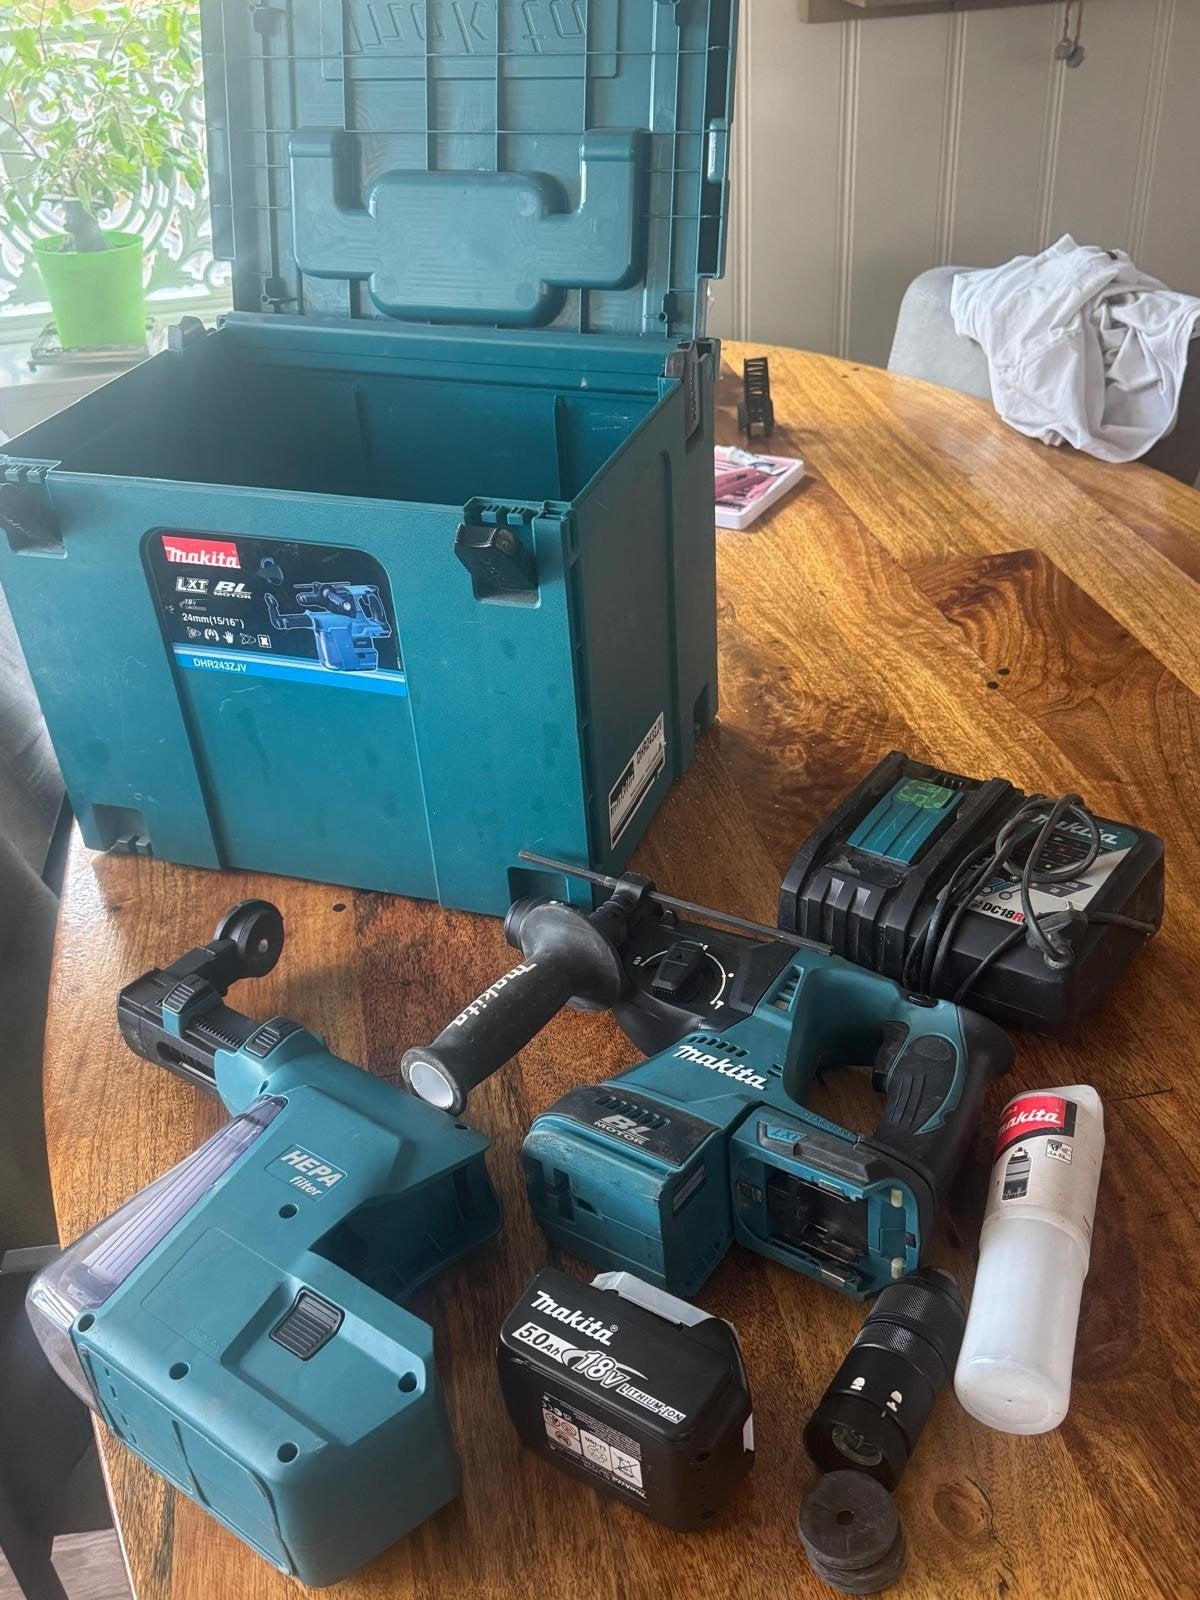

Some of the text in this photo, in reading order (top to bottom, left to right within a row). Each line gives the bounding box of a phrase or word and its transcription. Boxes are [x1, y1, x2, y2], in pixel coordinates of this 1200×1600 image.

[175, 576, 246, 594] LXT BL
[213, 591, 252, 600] MOTOR
[193, 658, 247, 672] DHR243ZJV
[593, 1120, 652, 1146] MOTOR
[605, 1114, 652, 1135] BL
[281, 1150, 343, 1187] HEPA
[290, 1176, 323, 1195] filter
